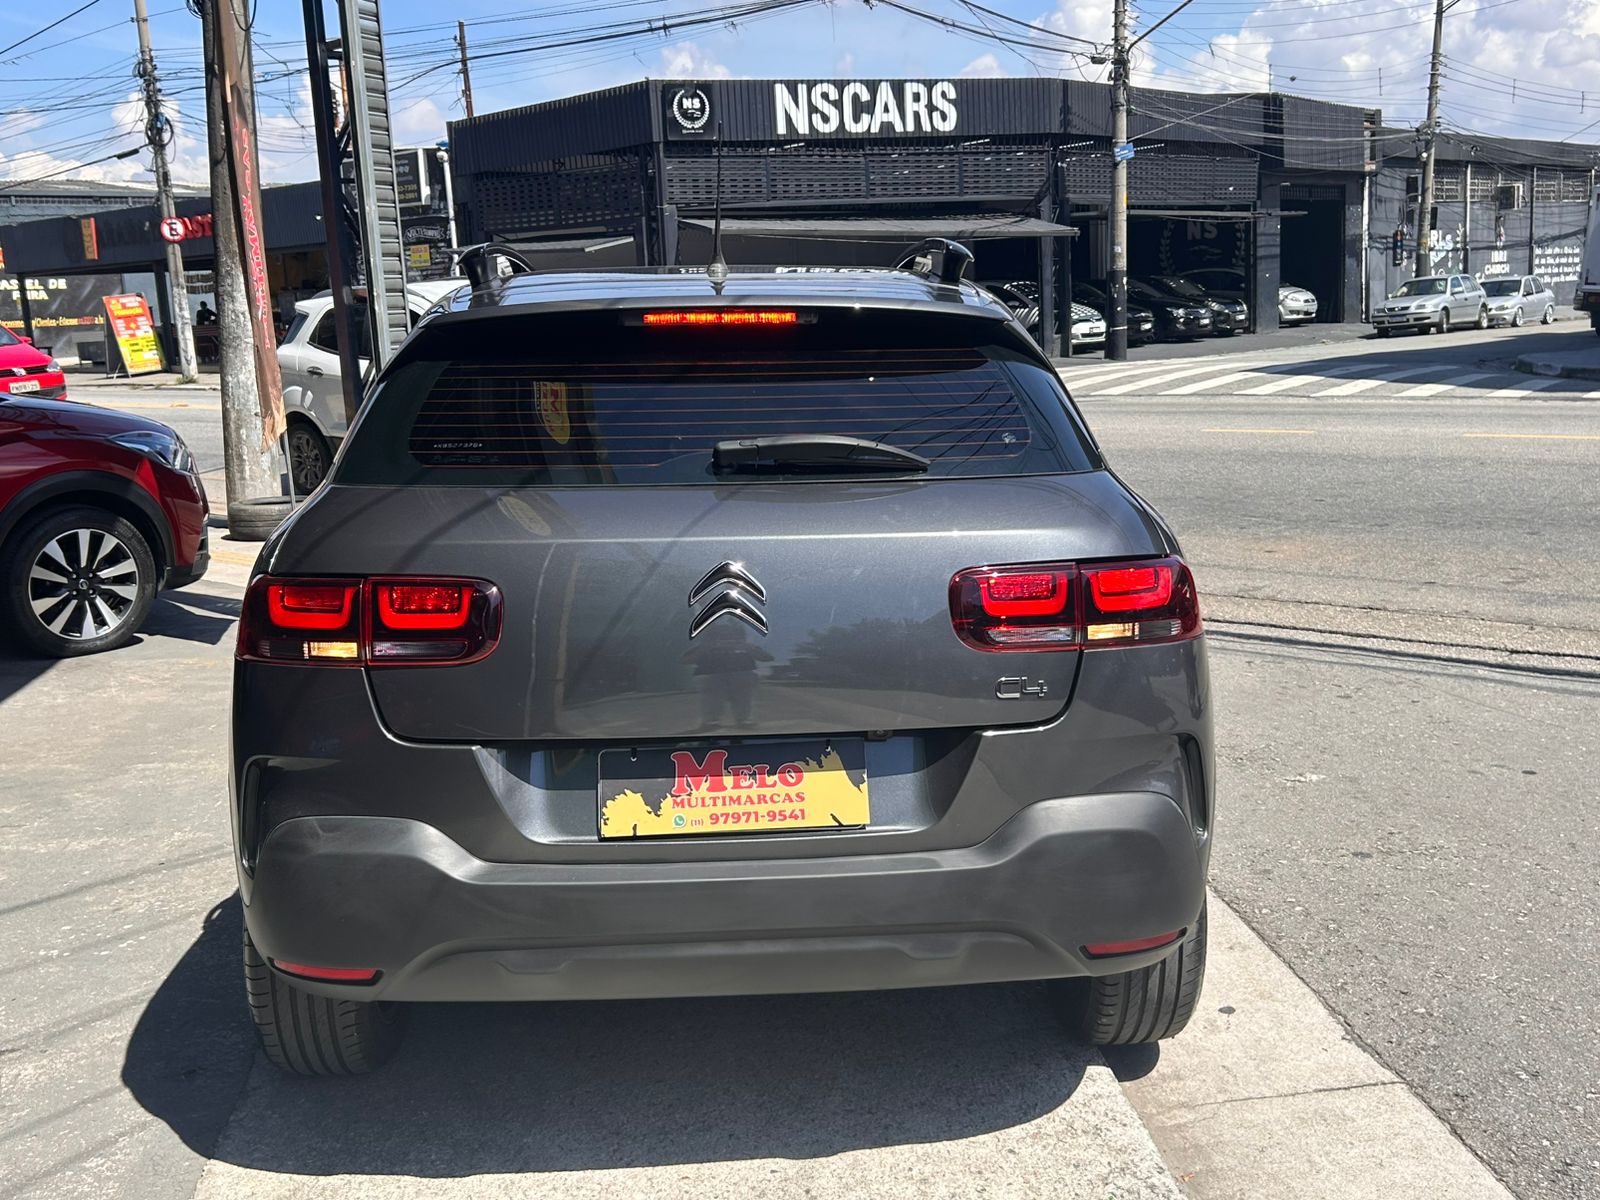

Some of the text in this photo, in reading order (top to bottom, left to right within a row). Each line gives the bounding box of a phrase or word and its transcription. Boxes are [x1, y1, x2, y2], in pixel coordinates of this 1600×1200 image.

[682, 97, 701, 109] NS
[774, 81, 957, 134] NSCARS
[1186, 219, 1218, 240] NS
[49, 278, 68, 289] DE
[12, 289, 49, 300] FIRA
[995, 676, 1048, 699] C4
[671, 750, 804, 796] MELO
[672, 792, 806, 809] MULTIMARCAS
[690, 809, 806, 827] (11) 97971-9541
